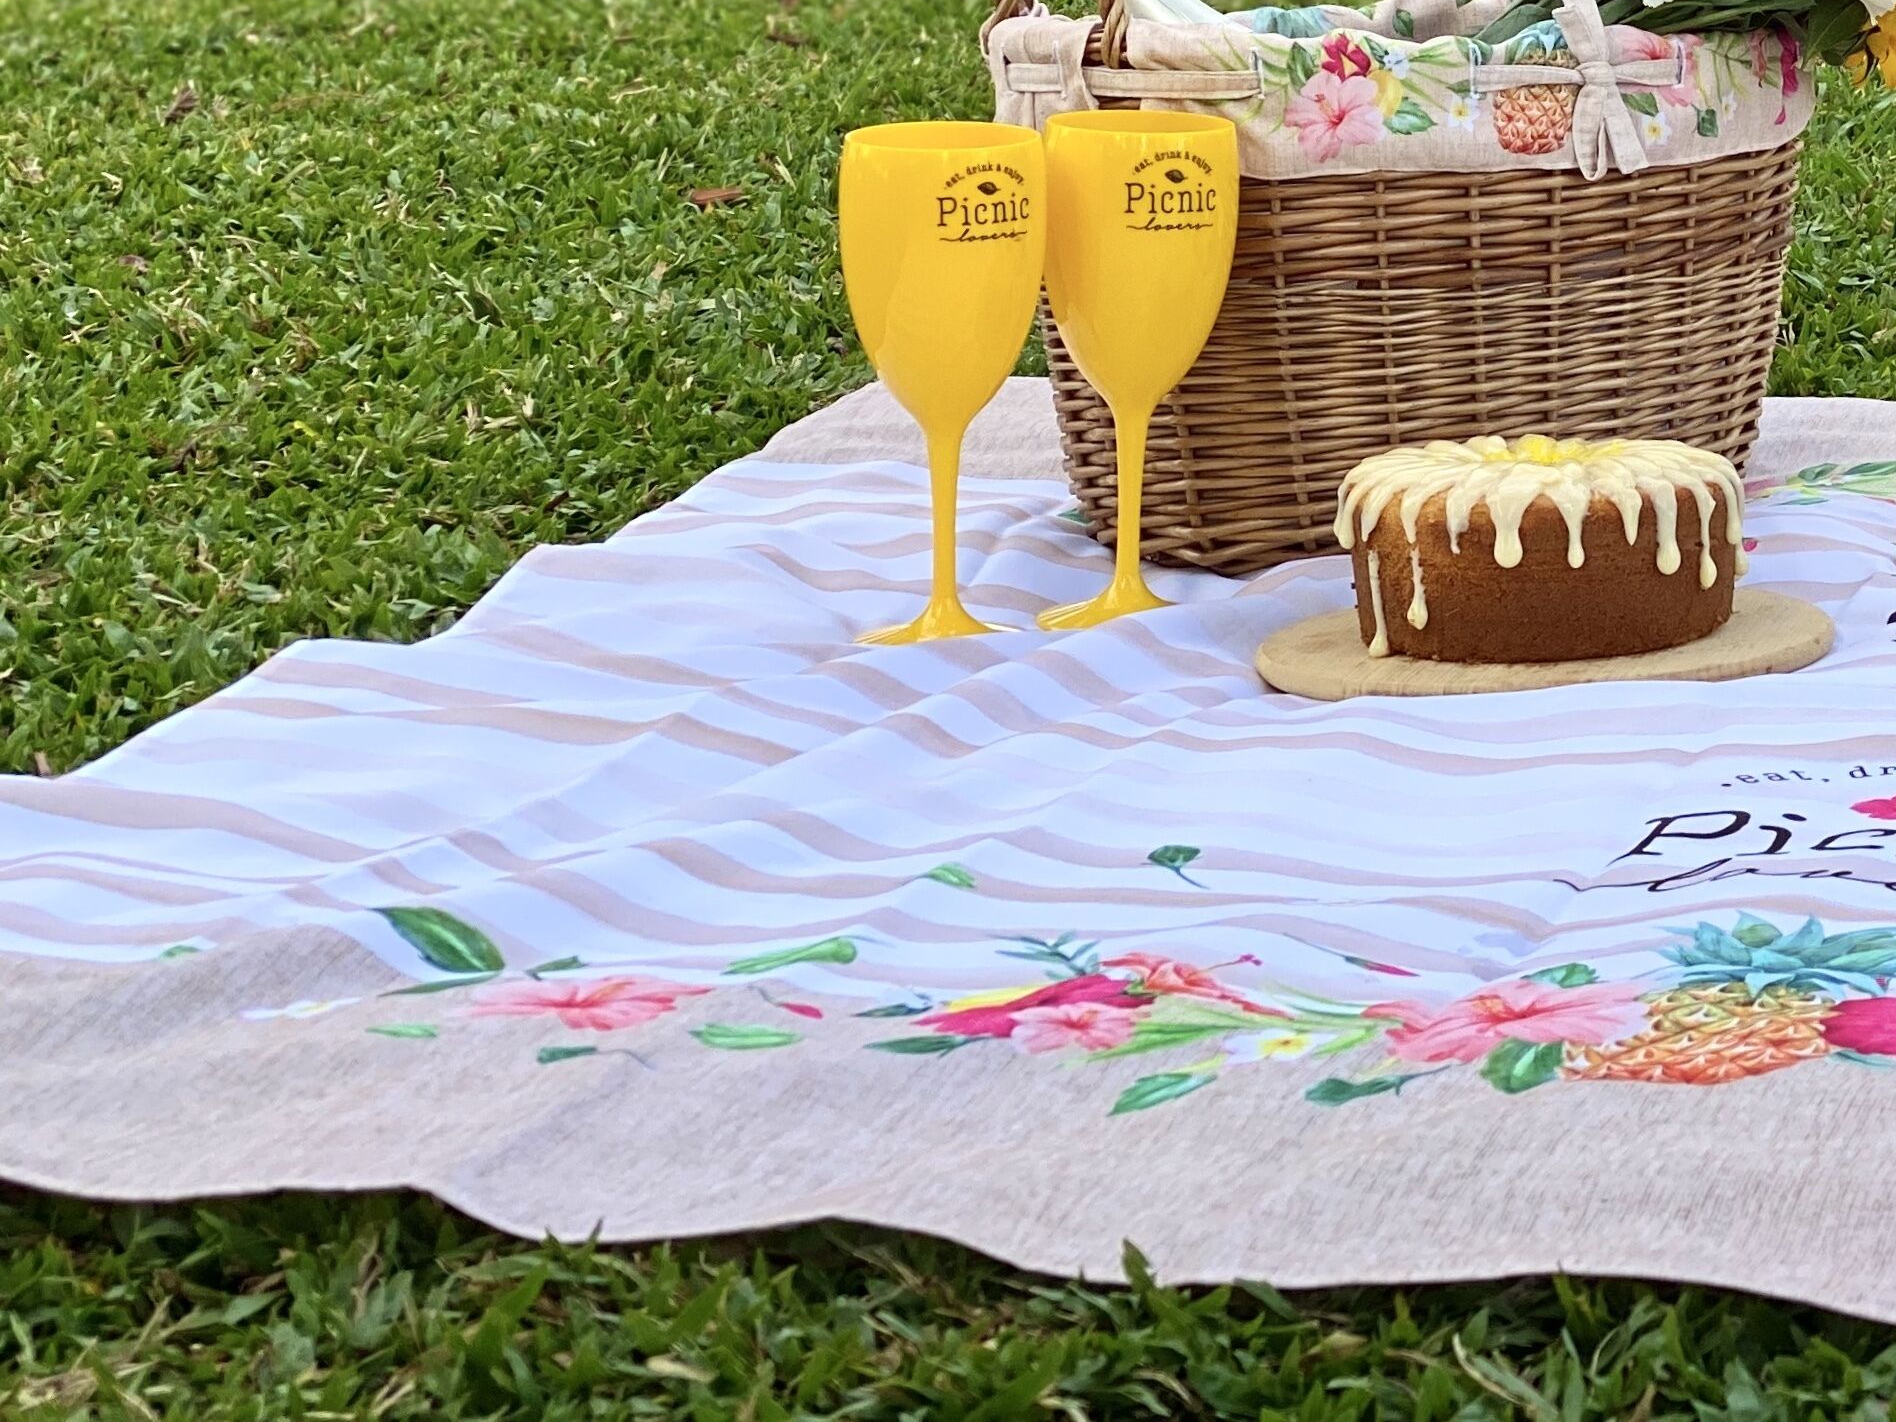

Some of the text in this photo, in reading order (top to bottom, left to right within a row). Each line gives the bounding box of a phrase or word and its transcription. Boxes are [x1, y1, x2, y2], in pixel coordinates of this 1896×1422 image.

[1154, 151, 1181, 162] drink
[966, 162, 993, 175] drink
[1124, 182, 1216, 214] Picnic
[936, 192, 1030, 227] Picnic
[1126, 216, 1214, 231] lovers
[939, 228, 1028, 242] lovers
